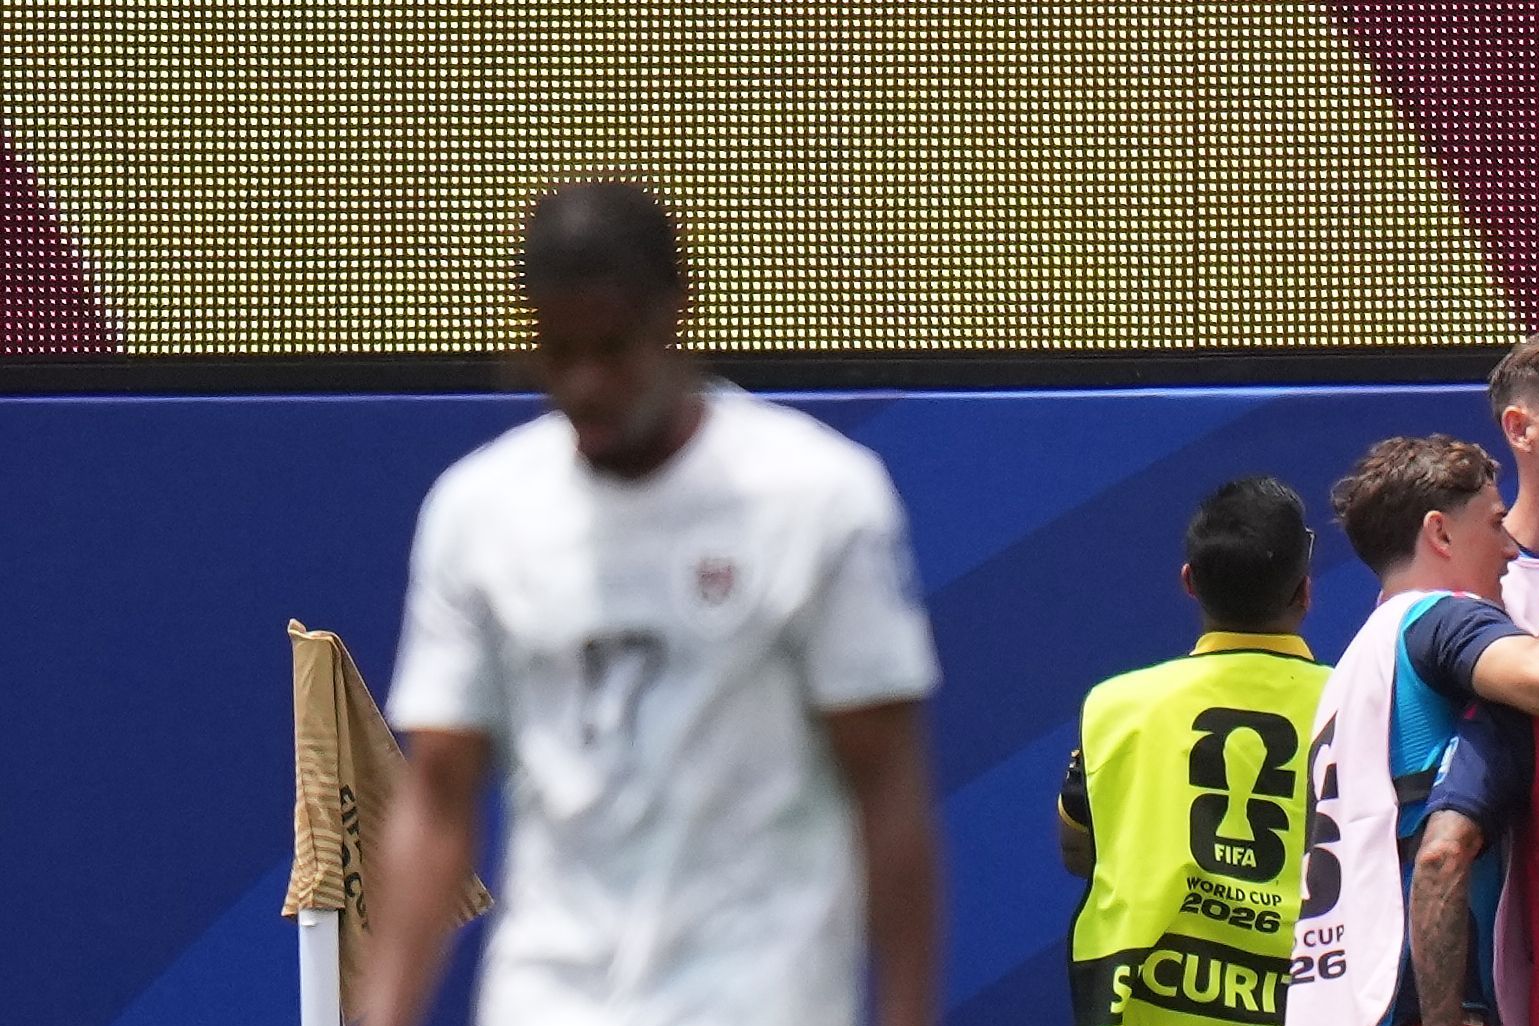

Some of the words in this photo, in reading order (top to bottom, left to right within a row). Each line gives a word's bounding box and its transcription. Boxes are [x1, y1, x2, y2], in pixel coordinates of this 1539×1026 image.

[1214, 843, 1257, 868] FIFA
[1186, 876, 1246, 902] WORLD
[1250, 891, 1282, 907] CUP
[1179, 892, 1282, 934] 2026
[1303, 924, 1345, 948] CUP
[1110, 949, 1293, 1014] SCURI
